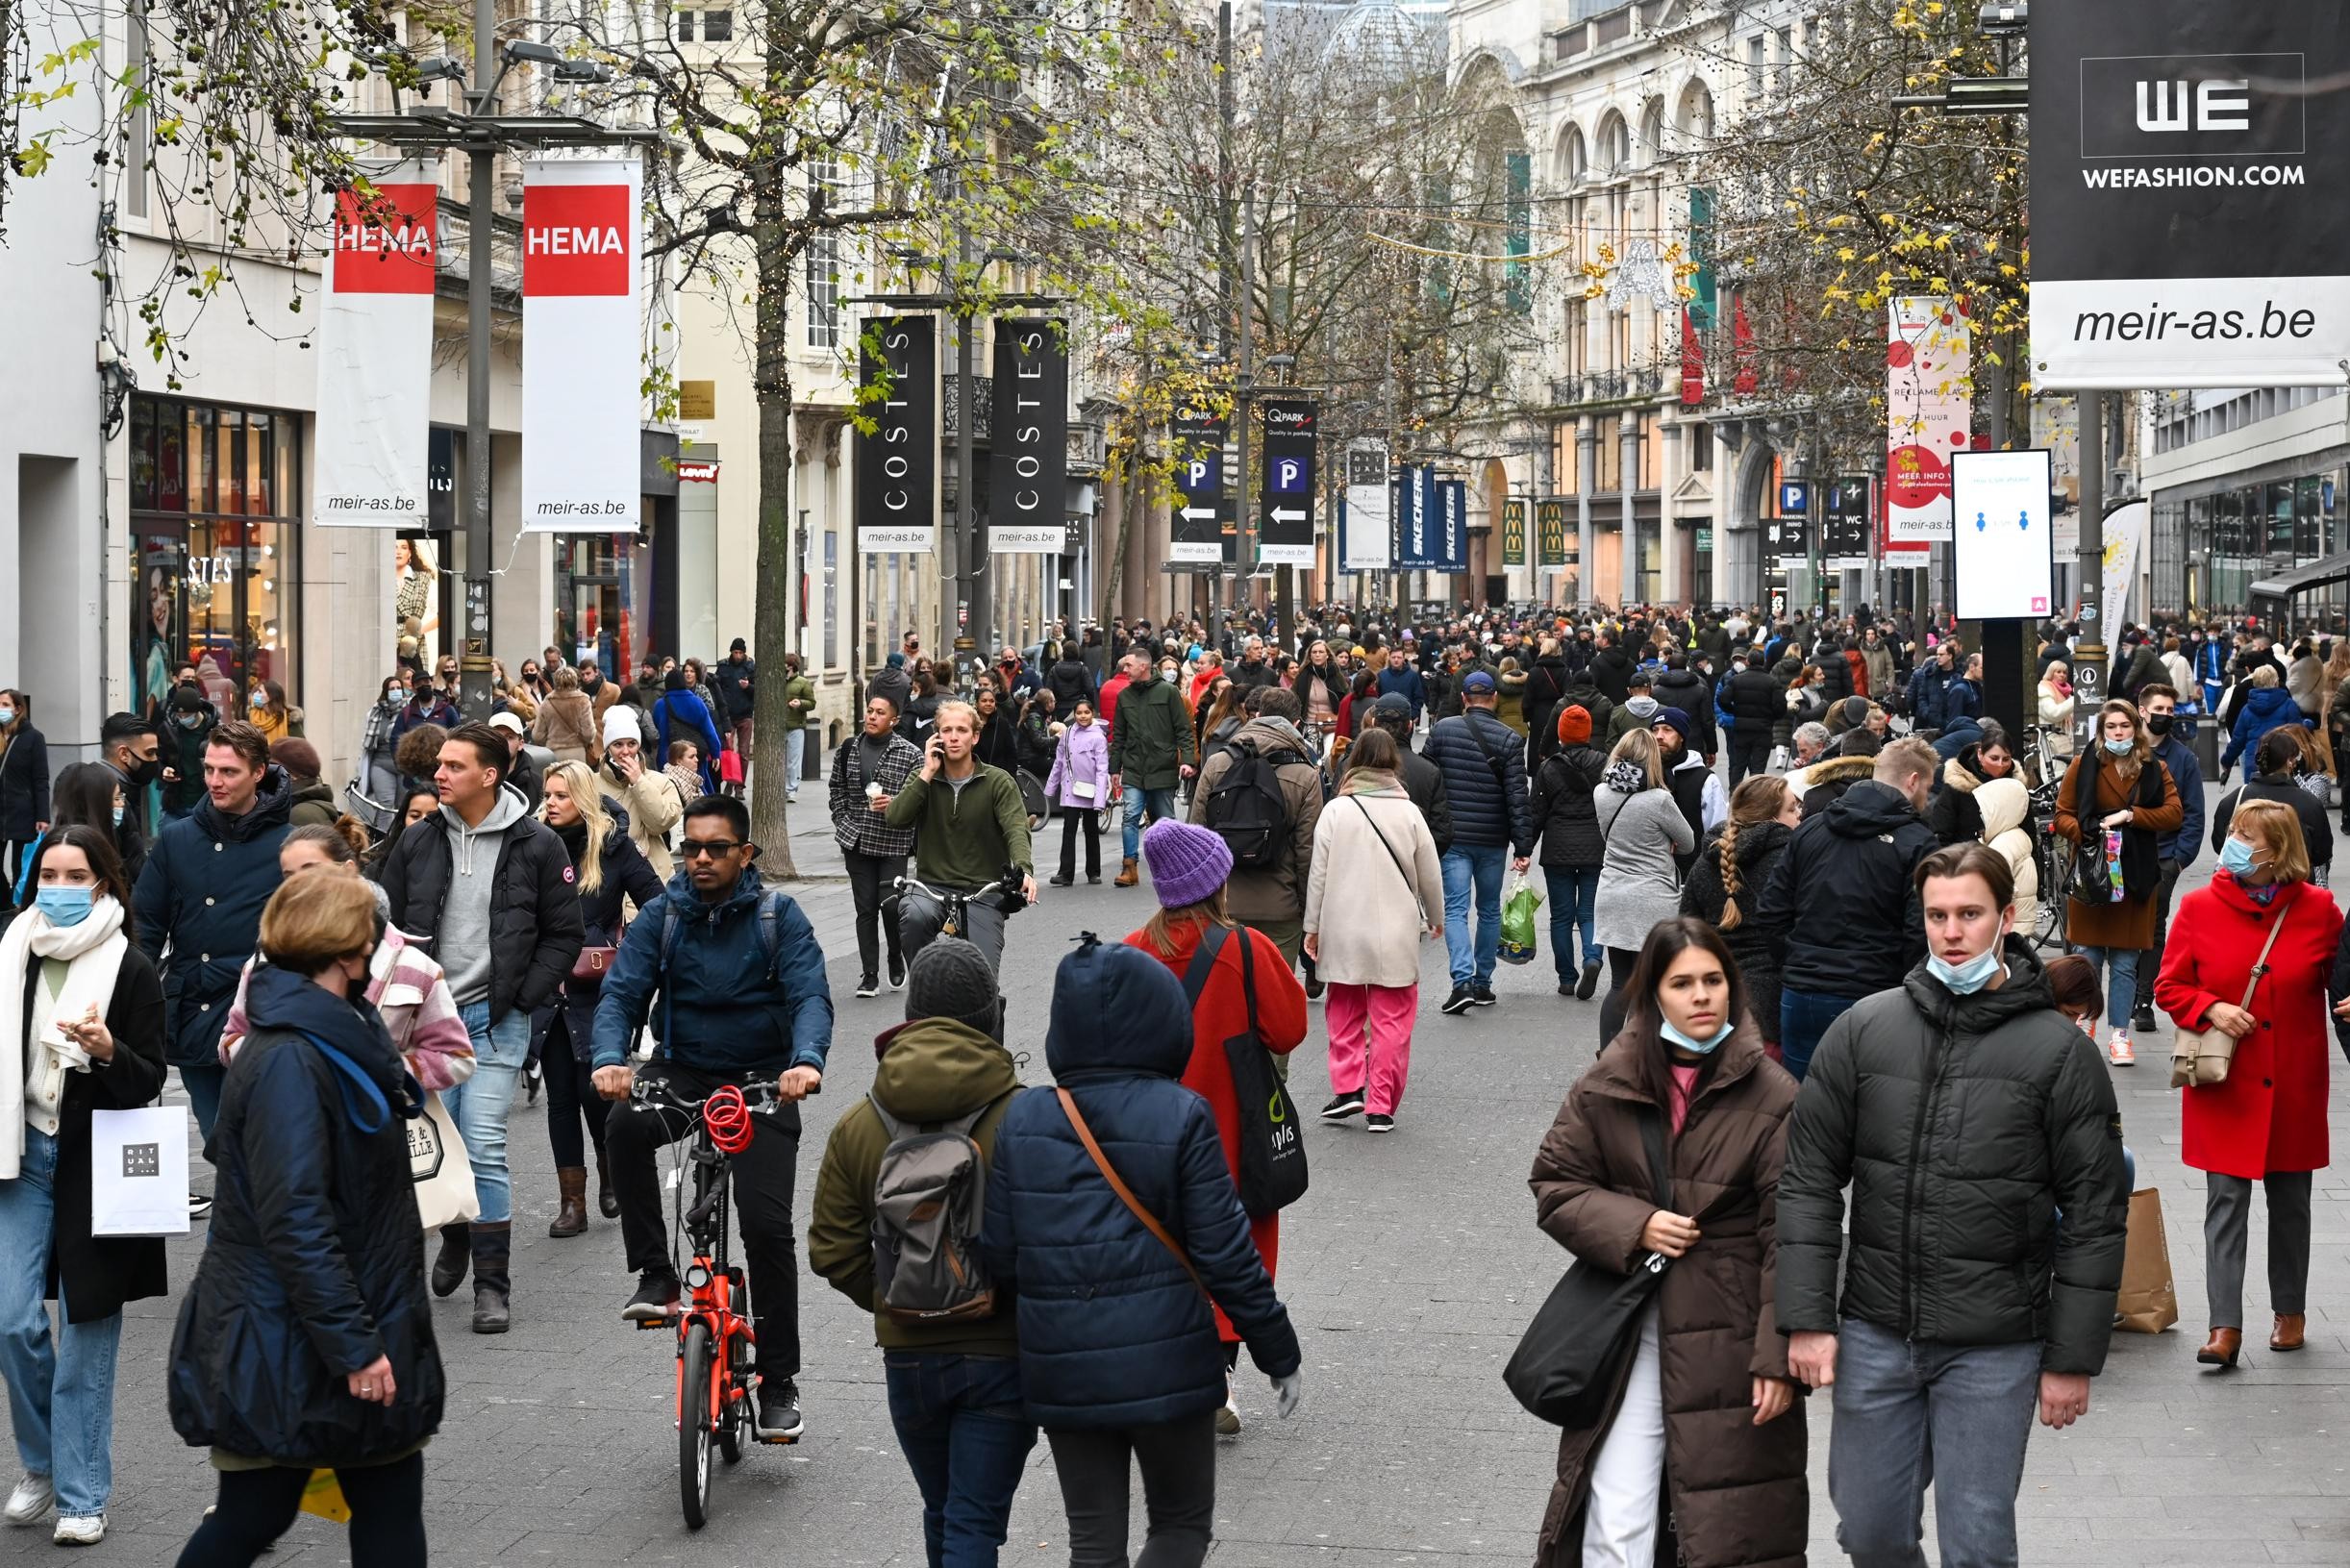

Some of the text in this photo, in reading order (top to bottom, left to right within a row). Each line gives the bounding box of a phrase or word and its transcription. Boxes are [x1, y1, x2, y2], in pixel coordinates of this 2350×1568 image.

[2137, 79, 2248, 132] WE
[2083, 165, 2305, 189] WEFASHION.COM
[338, 224, 432, 252] HEMA
[529, 227, 624, 255] HEMA
[2074, 300, 2315, 341] meir-as.be
[885, 333, 909, 510] COSTES
[1015, 333, 1042, 510] COSTES
[1190, 462, 1207, 486] P
[1282, 464, 1297, 488] P
[328, 495, 415, 511] meir-as.be
[538, 499, 625, 515] meir-as.be
[1788, 487, 1802, 508] P
[1412, 468, 1423, 557] SKECHERS
[1446, 485, 1455, 561] SKECHERS
[1846, 515, 1862, 525] WC
[867, 532, 925, 543] meir-as.be
[998, 532, 1056, 543] meir-as.be
[1176, 546, 1216, 555] meir-as.be
